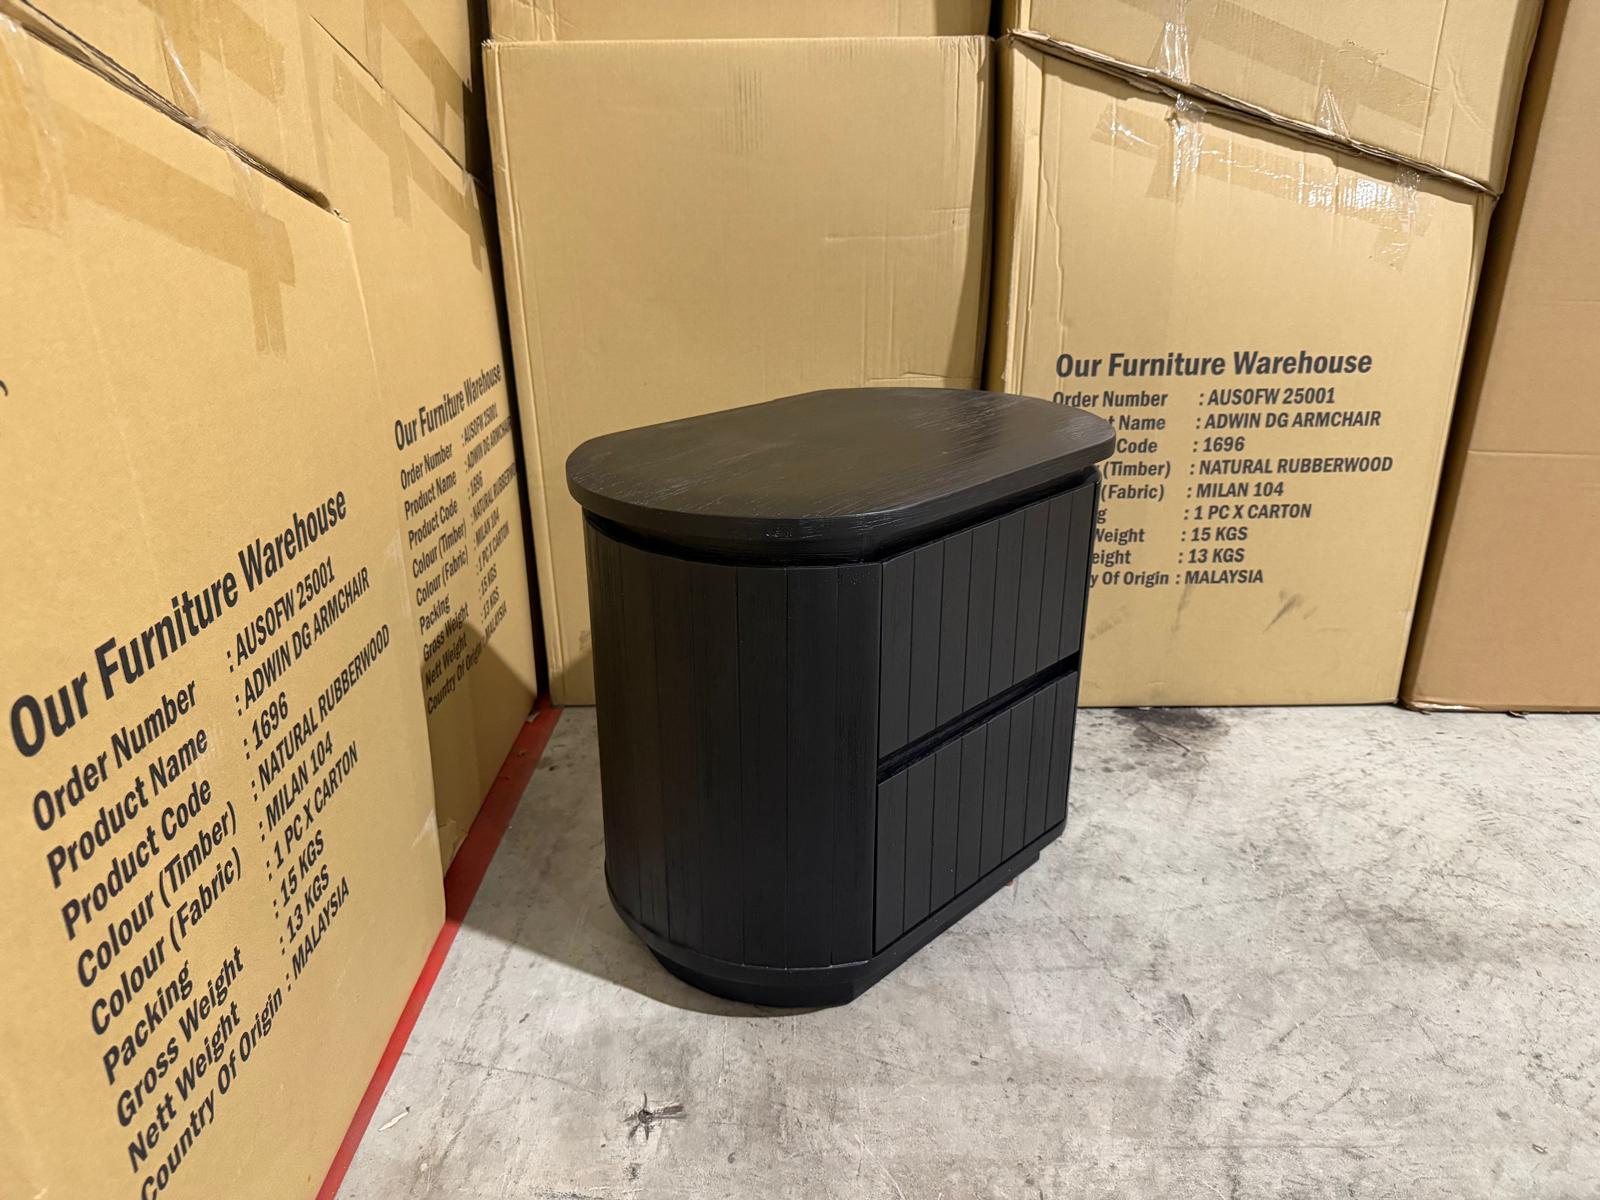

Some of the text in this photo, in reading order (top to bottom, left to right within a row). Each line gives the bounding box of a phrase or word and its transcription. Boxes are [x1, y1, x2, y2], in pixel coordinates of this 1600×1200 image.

[1052, 391, 1099, 408] Order
[1102, 391, 1168, 407] Number
[1207, 388, 1280, 405] AUSOFW
[1282, 387, 1335, 405] 25001
[1056, 350, 1373, 378] Our Furniture Warehouse
[1118, 415, 1166, 430] Name
[1204, 413, 1261, 429] ADWIN
[1265, 412, 1289, 428] DG
[1291, 410, 1381, 428] ARMCHAIR
[1101, 484, 1165, 502] (Fabric)
[1196, 483, 1249, 498] MILAN
[1253, 482, 1285, 497] 104
[1103, 461, 1171, 479] (Timber)
[1199, 459, 1273, 475] NATURAL
[1277, 457, 1393, 474] RUBBERWOOD
[1116, 438, 1158, 453] Code
[1203, 436, 1246, 452] 1696
[1194, 505, 1203, 520] 1
[1208, 505, 1230, 519] PC
[1232, 504, 1244, 519] X
[1247, 503, 1312, 519] CARTON
[1092, 550, 1131, 567] eight
[1188, 549, 1208, 564] 13
[1212, 548, 1245, 563] KGS
[1102, 571, 1120, 585] Of
[1123, 571, 1169, 588] Origin
[1184, 569, 1264, 585] MALAYSIA
[1191, 528, 1211, 542] 15
[1215, 527, 1249, 541] KGS
[10, 491, 347, 758] Our Furniture Warehouse
[33, 750, 108, 831] Order
[111, 680, 196, 769] Number
[236, 588, 295, 666] AUSOFW
[296, 555, 335, 611] 25001
[46, 775, 149, 889] Product
[148, 729, 208, 797] Name
[244, 641, 292, 710] ADWIN
[291, 622, 313, 661] DG
[313, 566, 370, 642] ARMCHAIR
[61, 825, 160, 941] Product
[161, 779, 212, 841] Code
[252, 691, 289, 750] 1696
[77, 890, 154, 988] Colour
[159, 800, 236, 909] (Timber)
[258, 707, 319, 792] NATURAL
[318, 624, 390, 722] RUBBERWOOD
[91, 936, 165, 1035] Colour
[169, 846, 241, 953] (Fabric)
[266, 760, 309, 832] MILAN
[310, 730, 333, 775] 104
[102, 959, 193, 1086] Packing
[274, 840, 284, 870] 1
[284, 813, 303, 854] PC
[302, 798, 314, 830] X
[314, 740, 359, 813] CARTON
[116, 1037, 179, 1128] Gross
[178, 946, 244, 1043] Weight
[280, 865, 298, 908] 15
[298, 829, 325, 880] KGS
[127, 1092, 177, 1174] Nett
[174, 1000, 241, 1101] Weight
[286, 903, 304, 943] 13
[304, 864, 330, 916] KGS
[141, 1088, 215, 1200] Country
[217, 1049, 236, 1095] Of
[239, 987, 282, 1062] Origin
[291, 876, 350, 980] MALAYSIA
